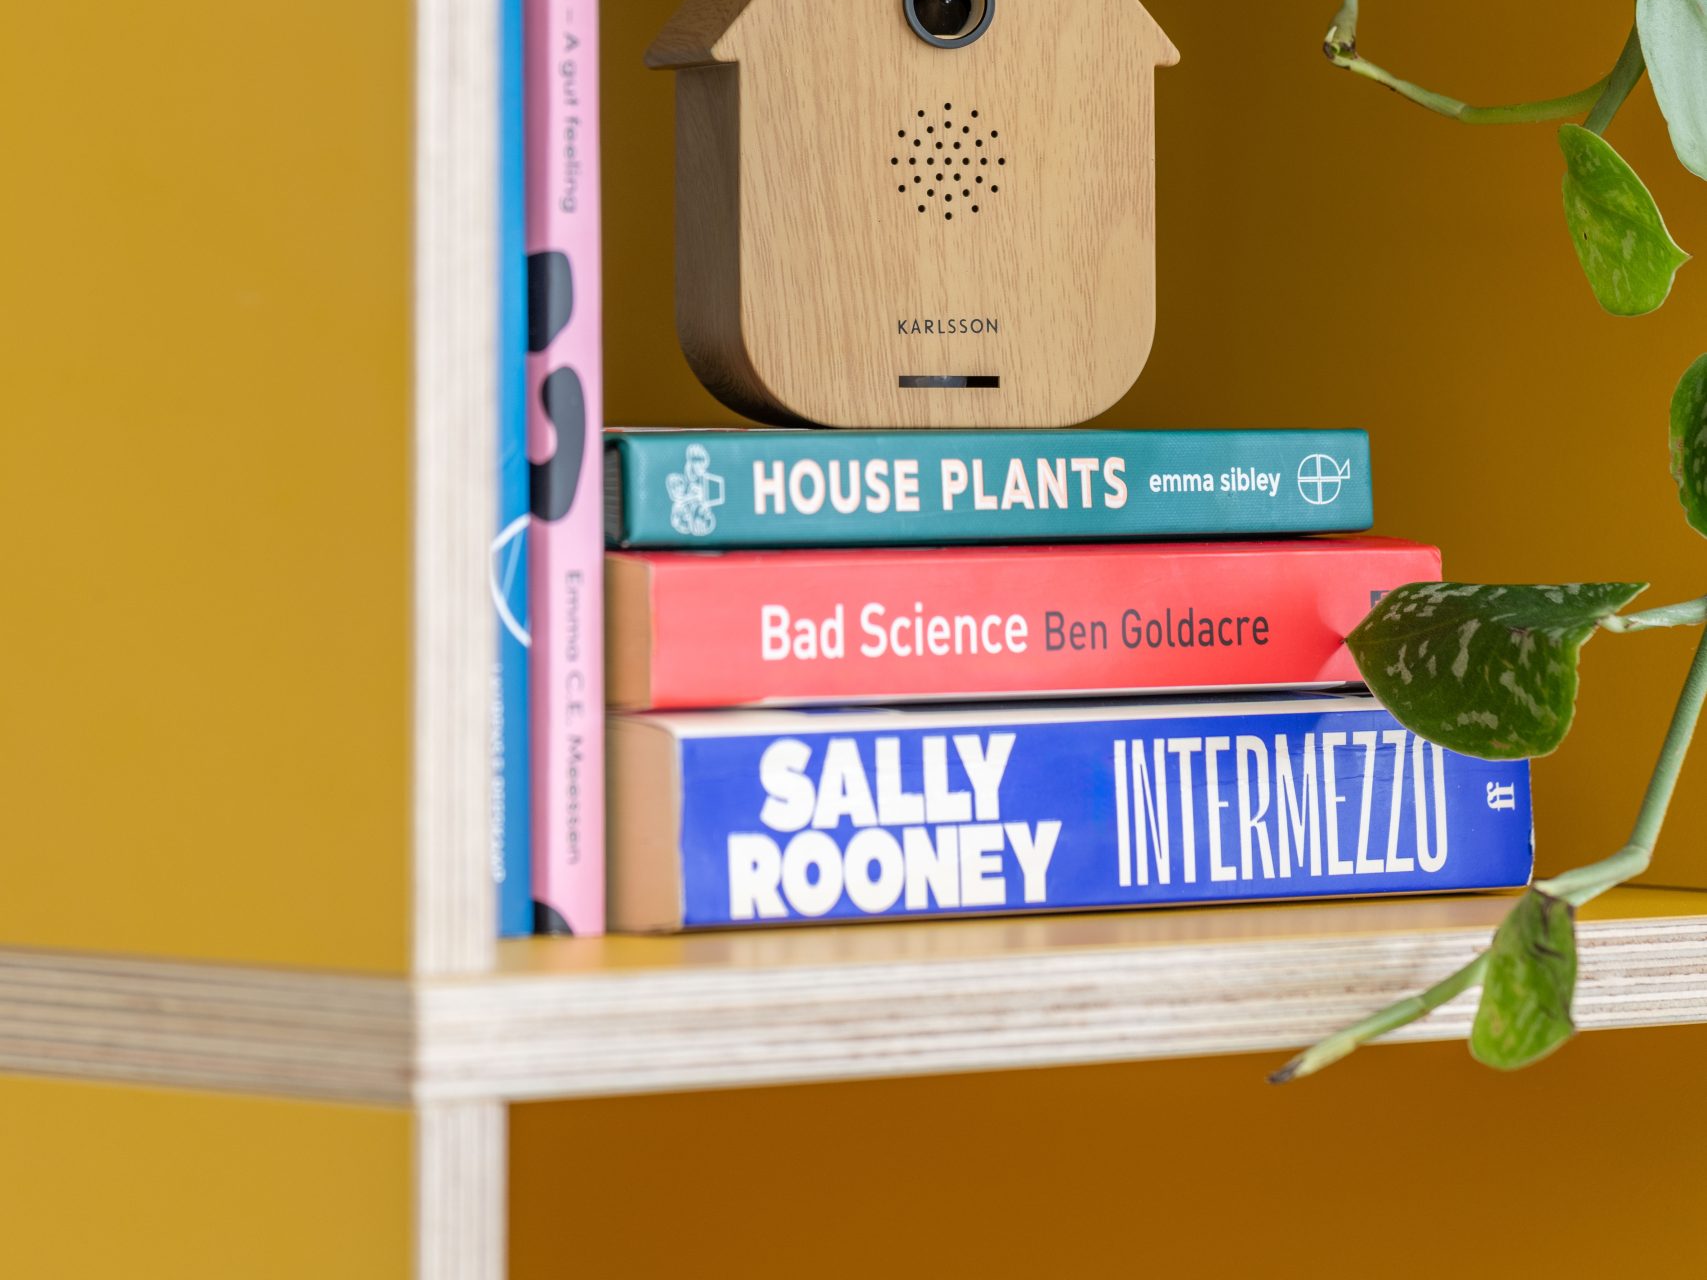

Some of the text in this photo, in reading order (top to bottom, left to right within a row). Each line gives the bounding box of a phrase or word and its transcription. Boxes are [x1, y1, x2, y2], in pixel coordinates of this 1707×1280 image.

[564, 31, 580, 52] A
[558, 60, 580, 108] gut
[558, 115, 581, 215] feeling
[897, 317, 999, 336] KARLSSON
[752, 455, 1129, 516] HOUSE PLANTS
[1148, 465, 1282, 499] emma sibley
[565, 568, 583, 663] Emma
[760, 600, 1030, 662] Bad Science
[1044, 606, 1270, 652] Ben Goldacre
[759, 732, 1016, 832] SALLY
[1113, 728, 1449, 888] INTERMEZZO
[726, 819, 1063, 920] ROONEY
